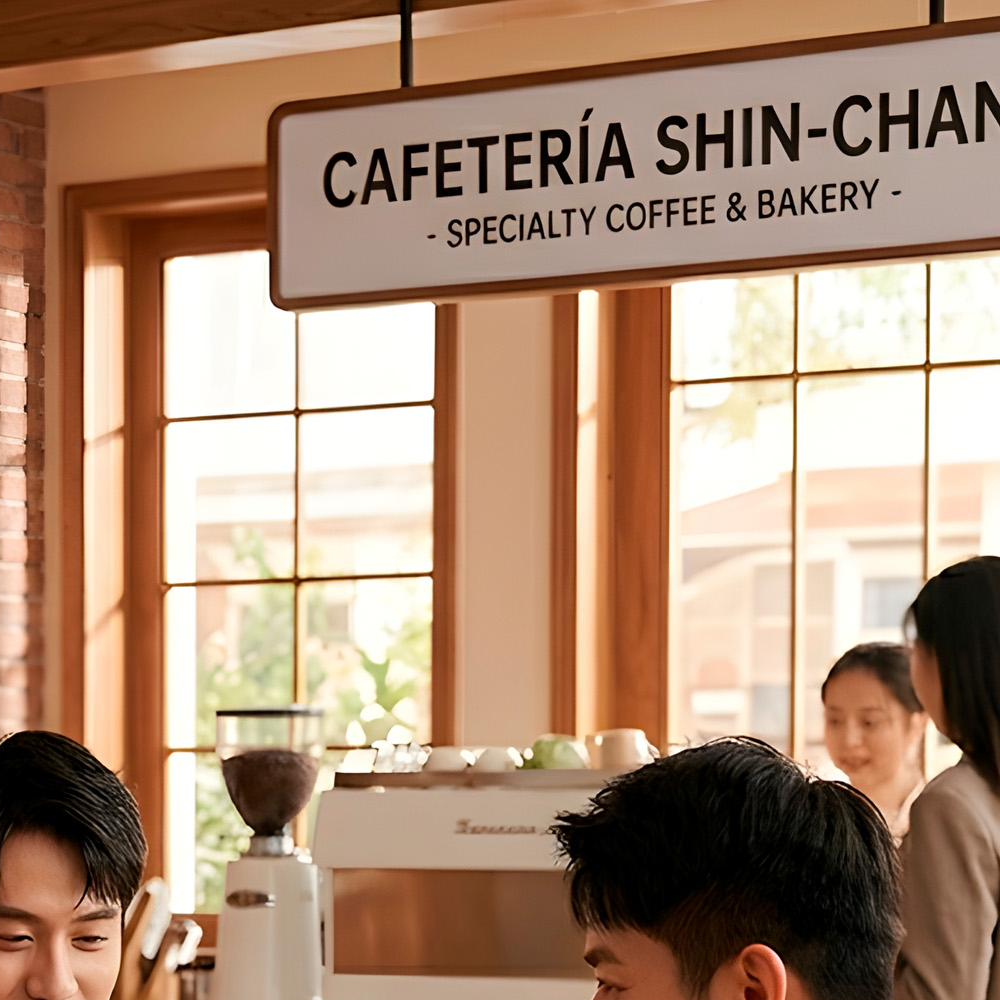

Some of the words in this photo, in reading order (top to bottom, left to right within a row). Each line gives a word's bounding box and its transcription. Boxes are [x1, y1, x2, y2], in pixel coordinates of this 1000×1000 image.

[322, 107, 636, 209] CAFETERÍA
[655, 80, 1000, 176] SHIN-CHAN
[446, 205, 597, 249] SPECIALTY
[605, 191, 716, 233] COFFEE
[726, 191, 747, 223] &
[757, 178, 880, 220] BAKERY
